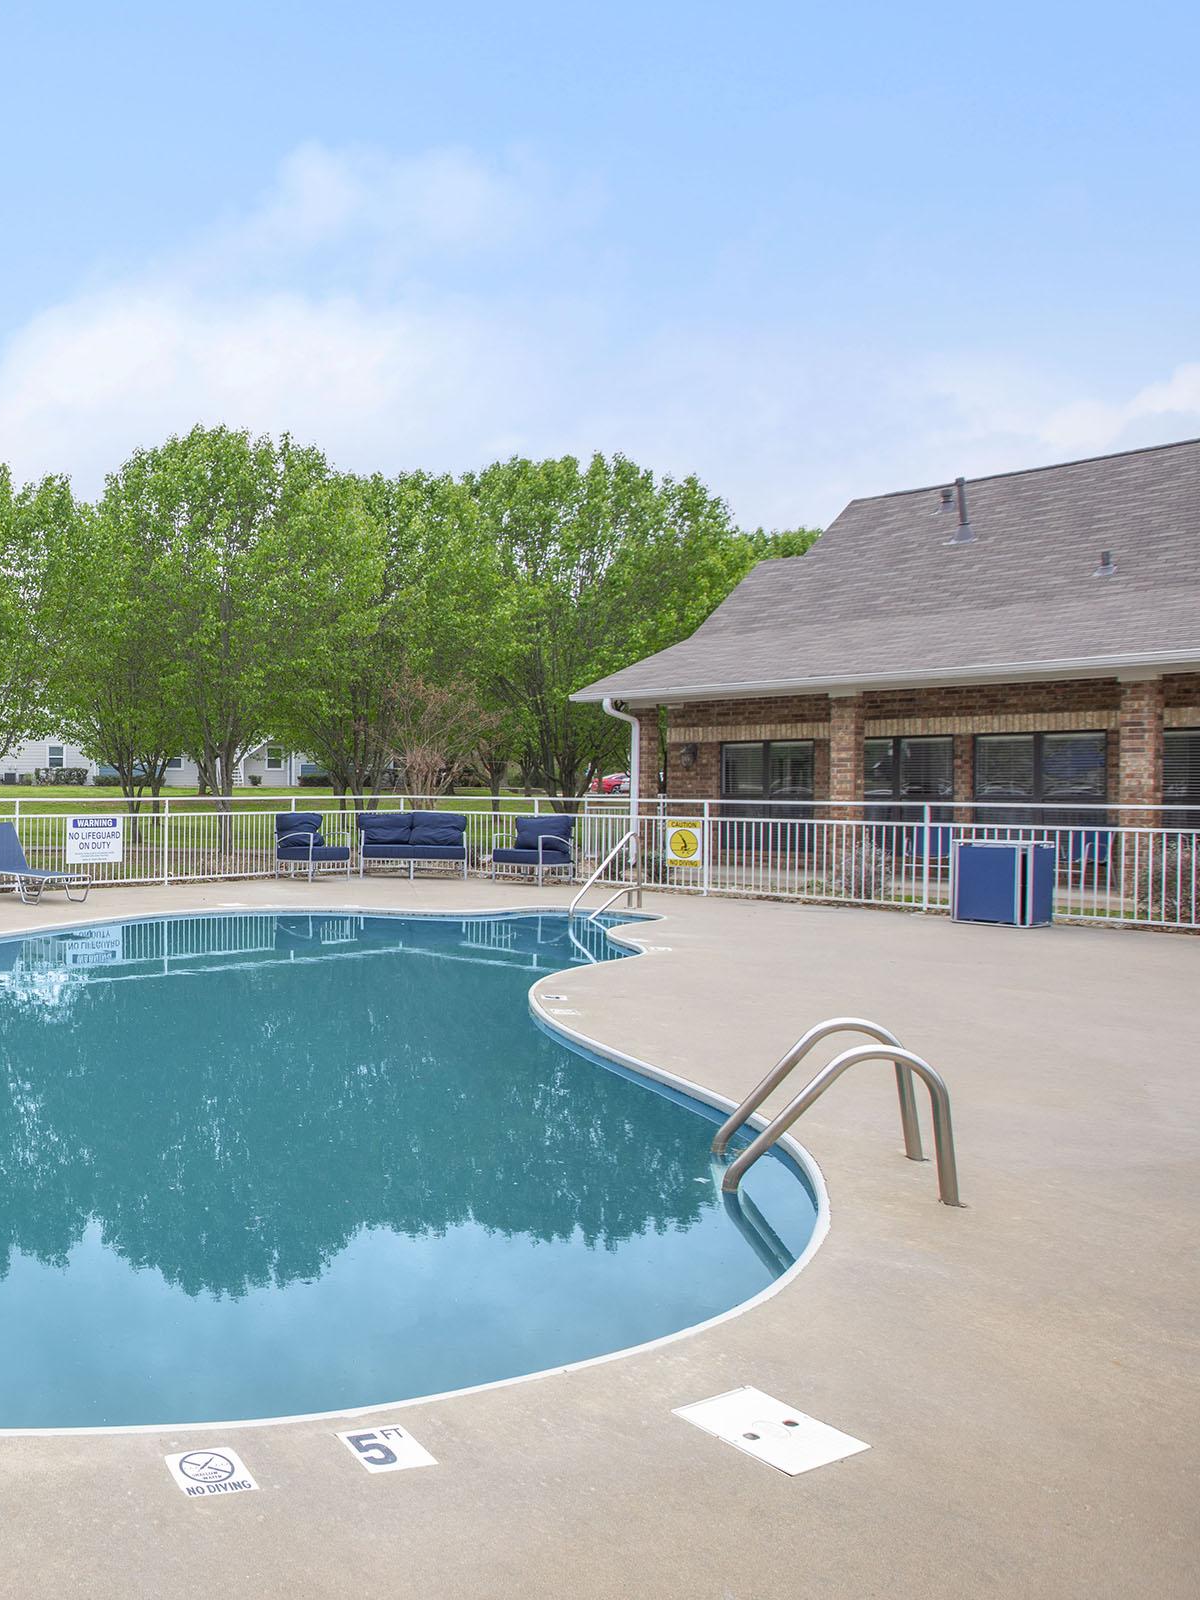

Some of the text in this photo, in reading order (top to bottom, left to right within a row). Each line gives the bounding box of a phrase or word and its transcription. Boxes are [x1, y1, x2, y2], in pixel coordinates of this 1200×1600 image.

[77, 819, 113, 828] WARNING
[69, 831, 121, 840] NO LIFEGUARD
[79, 841, 111, 850] ON DUTY
[346, 1428, 403, 1465] 5 FT
[186, 1480, 252, 1496] NO DIVING
